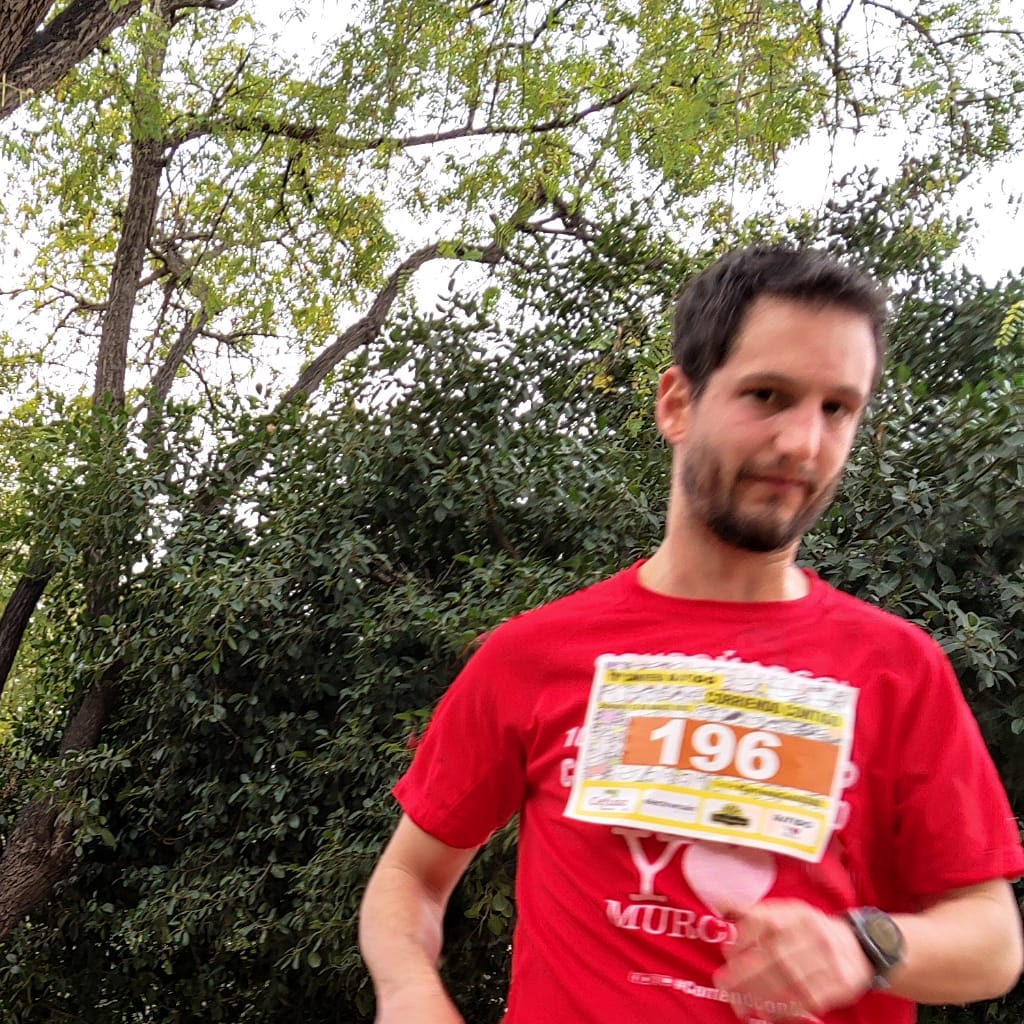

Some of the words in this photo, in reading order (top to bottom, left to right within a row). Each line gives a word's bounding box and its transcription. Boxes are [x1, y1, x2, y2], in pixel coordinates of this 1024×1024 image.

[649, 719, 782, 780] 196
[611, 826, 696, 902] Y
[604, 899, 738, 945] MURCI
